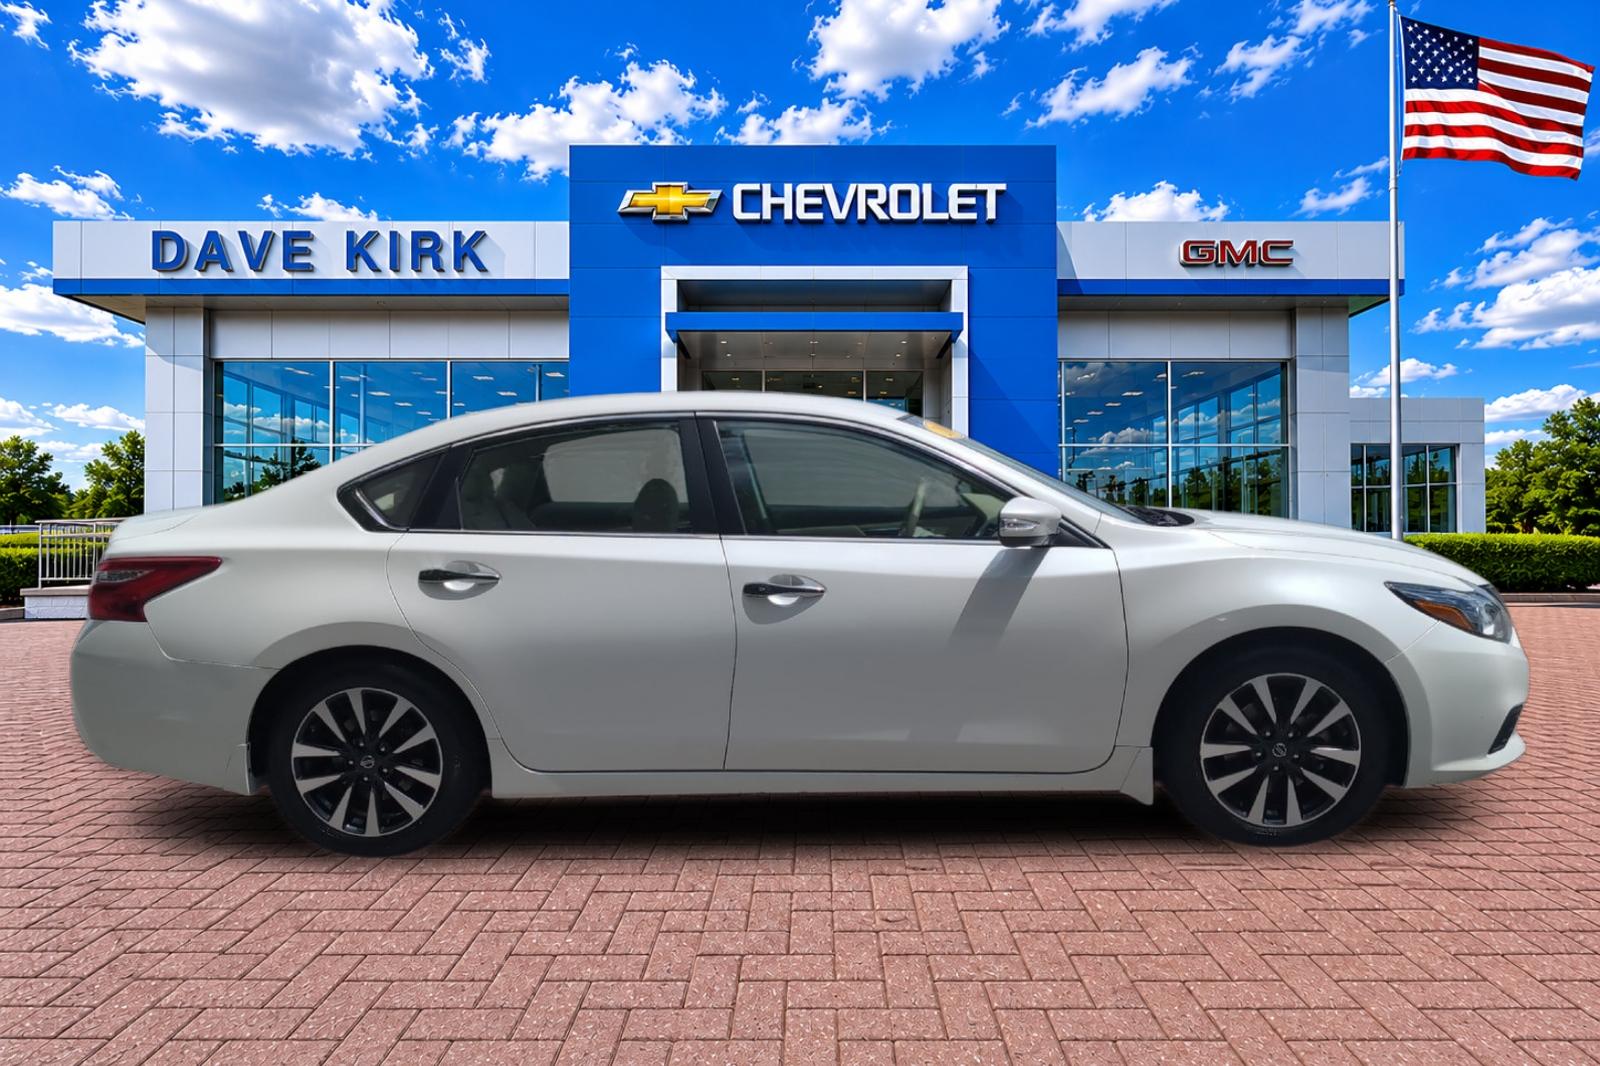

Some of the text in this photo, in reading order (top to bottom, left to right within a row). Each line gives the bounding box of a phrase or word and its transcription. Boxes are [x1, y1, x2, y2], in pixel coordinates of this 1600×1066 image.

[732, 183, 1008, 222] CHEVROLET
[151, 230, 489, 273] DAVE KIRK
[1179, 239, 1295, 267] GMC
